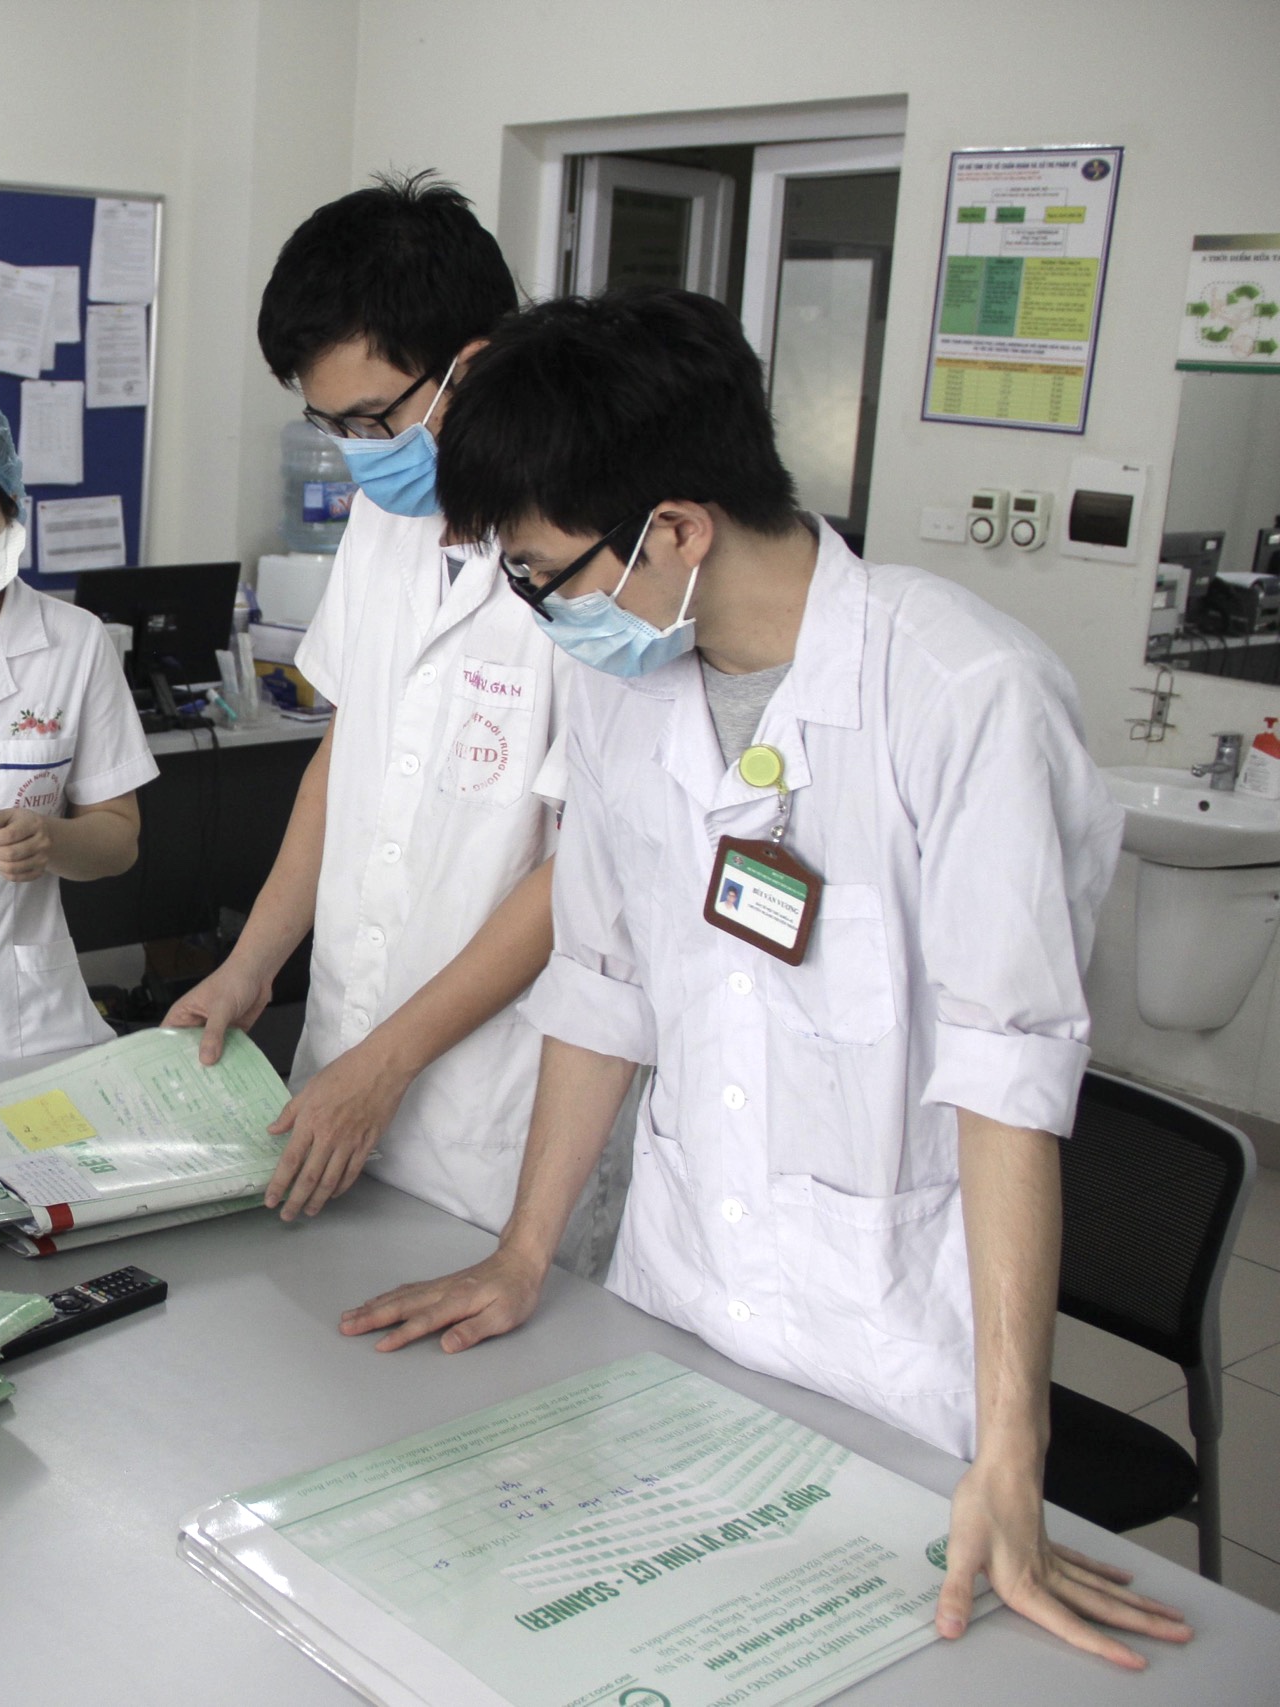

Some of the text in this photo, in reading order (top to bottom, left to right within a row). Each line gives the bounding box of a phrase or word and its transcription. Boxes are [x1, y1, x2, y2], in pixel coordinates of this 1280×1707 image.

[781, 1485, 831, 1511] CHỤP
[747, 1504, 788, 1528] CẮT
[693, 1534, 725, 1551] VI
[718, 1519, 757, 1542] LỚP
[652, 1544, 706, 1570] TÍNH
[623, 1560, 662, 1585] (CT
[847, 1577, 886, 1598] KHOA
[515, 1582, 620, 1631] SCANNER)
[771, 1613, 814, 1637] ĐOÁN
[855, 1615, 893, 1636] BỆNH
[818, 1632, 859, 1656] NHIỆT
[747, 1665, 796, 1690] TRUNG
